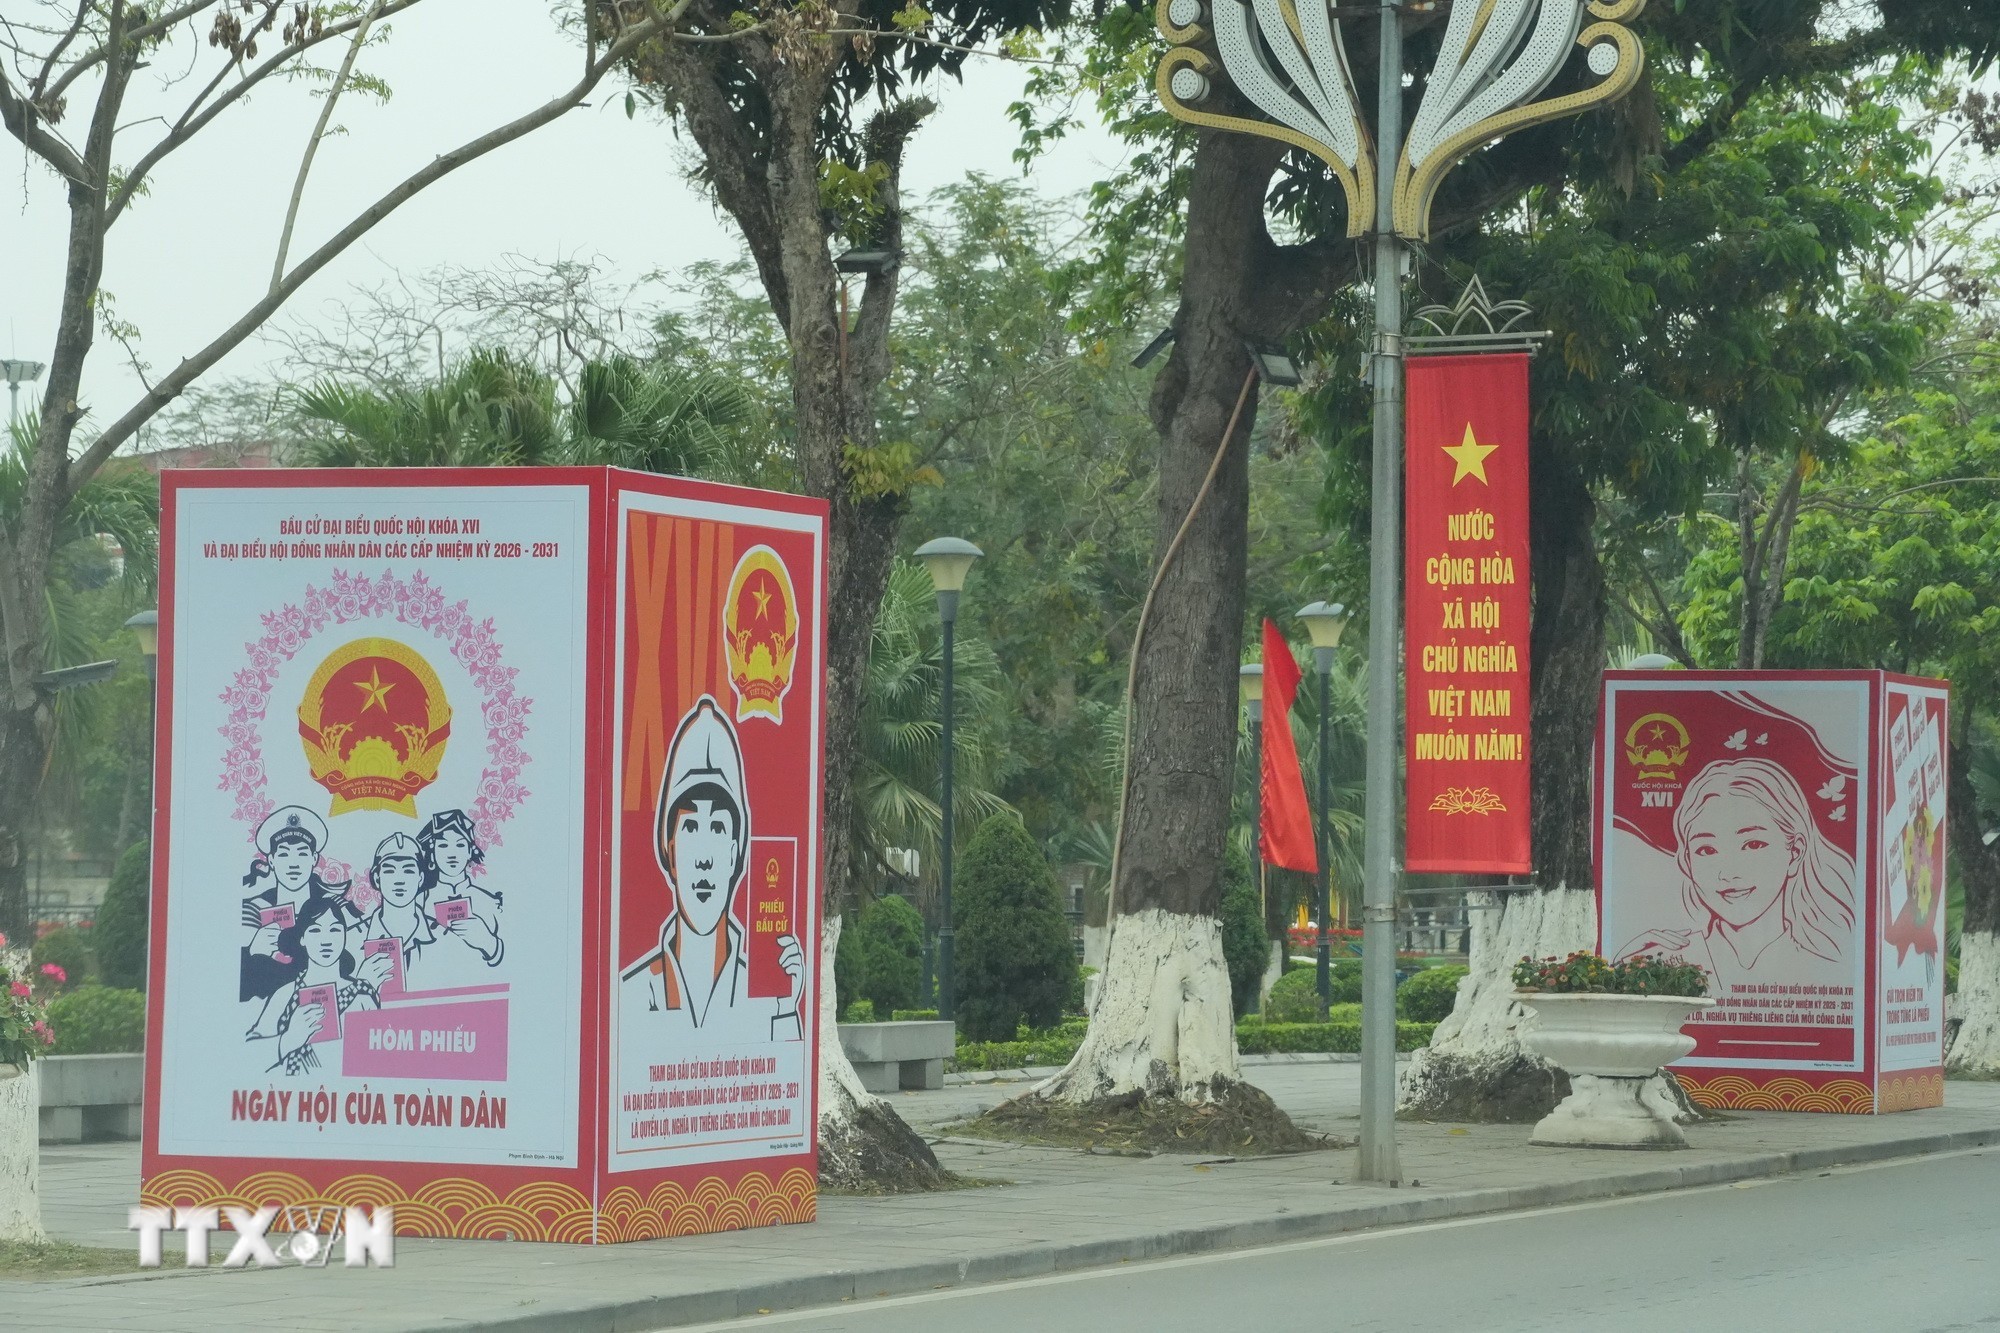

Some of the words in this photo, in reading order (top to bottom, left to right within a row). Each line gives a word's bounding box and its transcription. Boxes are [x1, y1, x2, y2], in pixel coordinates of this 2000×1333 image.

[306, 514, 322, 534] CỬ
[324, 520, 341, 537] ĐẠI
[345, 514, 370, 534] BIỂU
[374, 515, 403, 536] QUỐC
[407, 517, 424, 537] HỘI
[429, 516, 458, 534] KHÓA
[462, 519, 480, 534] XVI
[1448, 508, 1494, 541] NƯỚC
[204, 541, 218, 558] VÀ
[220, 544, 238, 561] ĐẠI
[242, 538, 266, 558] BIỂU
[270, 541, 288, 561] HỘI
[292, 539, 321, 558] ĐỒNG
[325, 541, 355, 558] NHÂN
[359, 541, 382, 558] DÂN
[385, 541, 407, 558] CÁC
[411, 538, 433, 558] CẤP
[437, 540, 472, 561] NHIỆM
[477, 540, 490, 558] KỲ
[494, 543, 521, 558] 2026
[533, 543, 558, 558] 2031
[1427, 553, 1474, 590] CỘNG
[1480, 551, 1514, 584] HÒA
[1443, 597, 1465, 628] XÃ
[1471, 596, 1499, 634] HỘI
[1423, 637, 1458, 673] CHỦ
[1464, 640, 1518, 673] NGHĨA
[1428, 685, 1465, 722] VIỆT
[1471, 690, 1510, 716] NAM
[1416, 729, 1469, 760] MUÔN
[1475, 728, 1522, 760] NĂM!
[351, 785, 372, 795] VIỆT
[375, 786, 396, 796] NAM
[1641, 792, 1673, 807] XVI
[369, 1024, 414, 1051] HÒM
[420, 1024, 476, 1053] PHIẾU
[232, 1084, 292, 1122] NGÀY
[298, 1085, 337, 1132] HỘI
[345, 1084, 387, 1125] CỦA
[394, 1088, 452, 1127] TOÀN
[461, 1090, 506, 1129] DÂN
